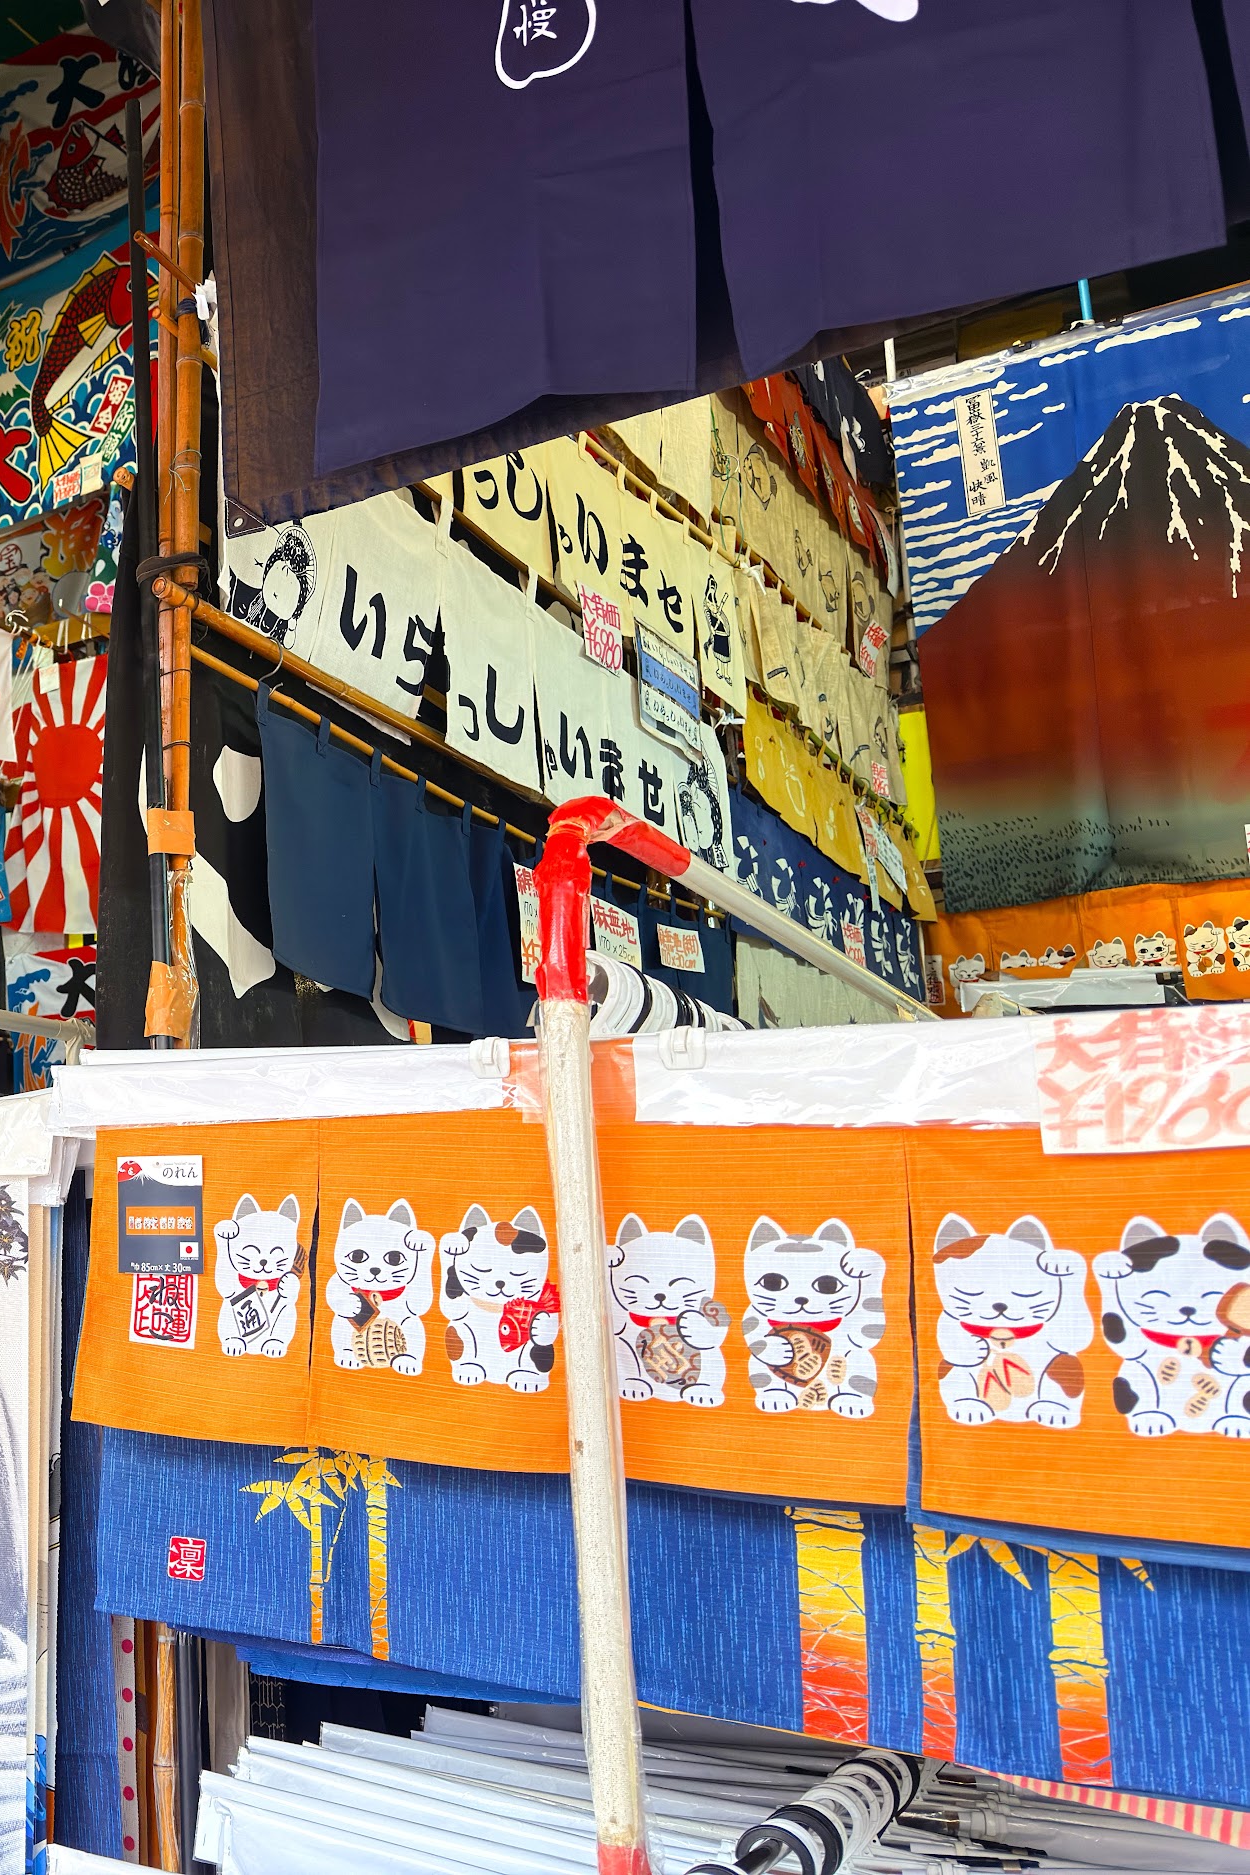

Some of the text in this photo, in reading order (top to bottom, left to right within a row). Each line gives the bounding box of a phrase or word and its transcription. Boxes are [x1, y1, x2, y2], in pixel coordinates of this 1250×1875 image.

[46, 52, 106, 129] 大
[4, 309, 40, 372] 祝
[969, 479, 987, 506] 快晴
[162, 1166, 199, 1179] のれん
